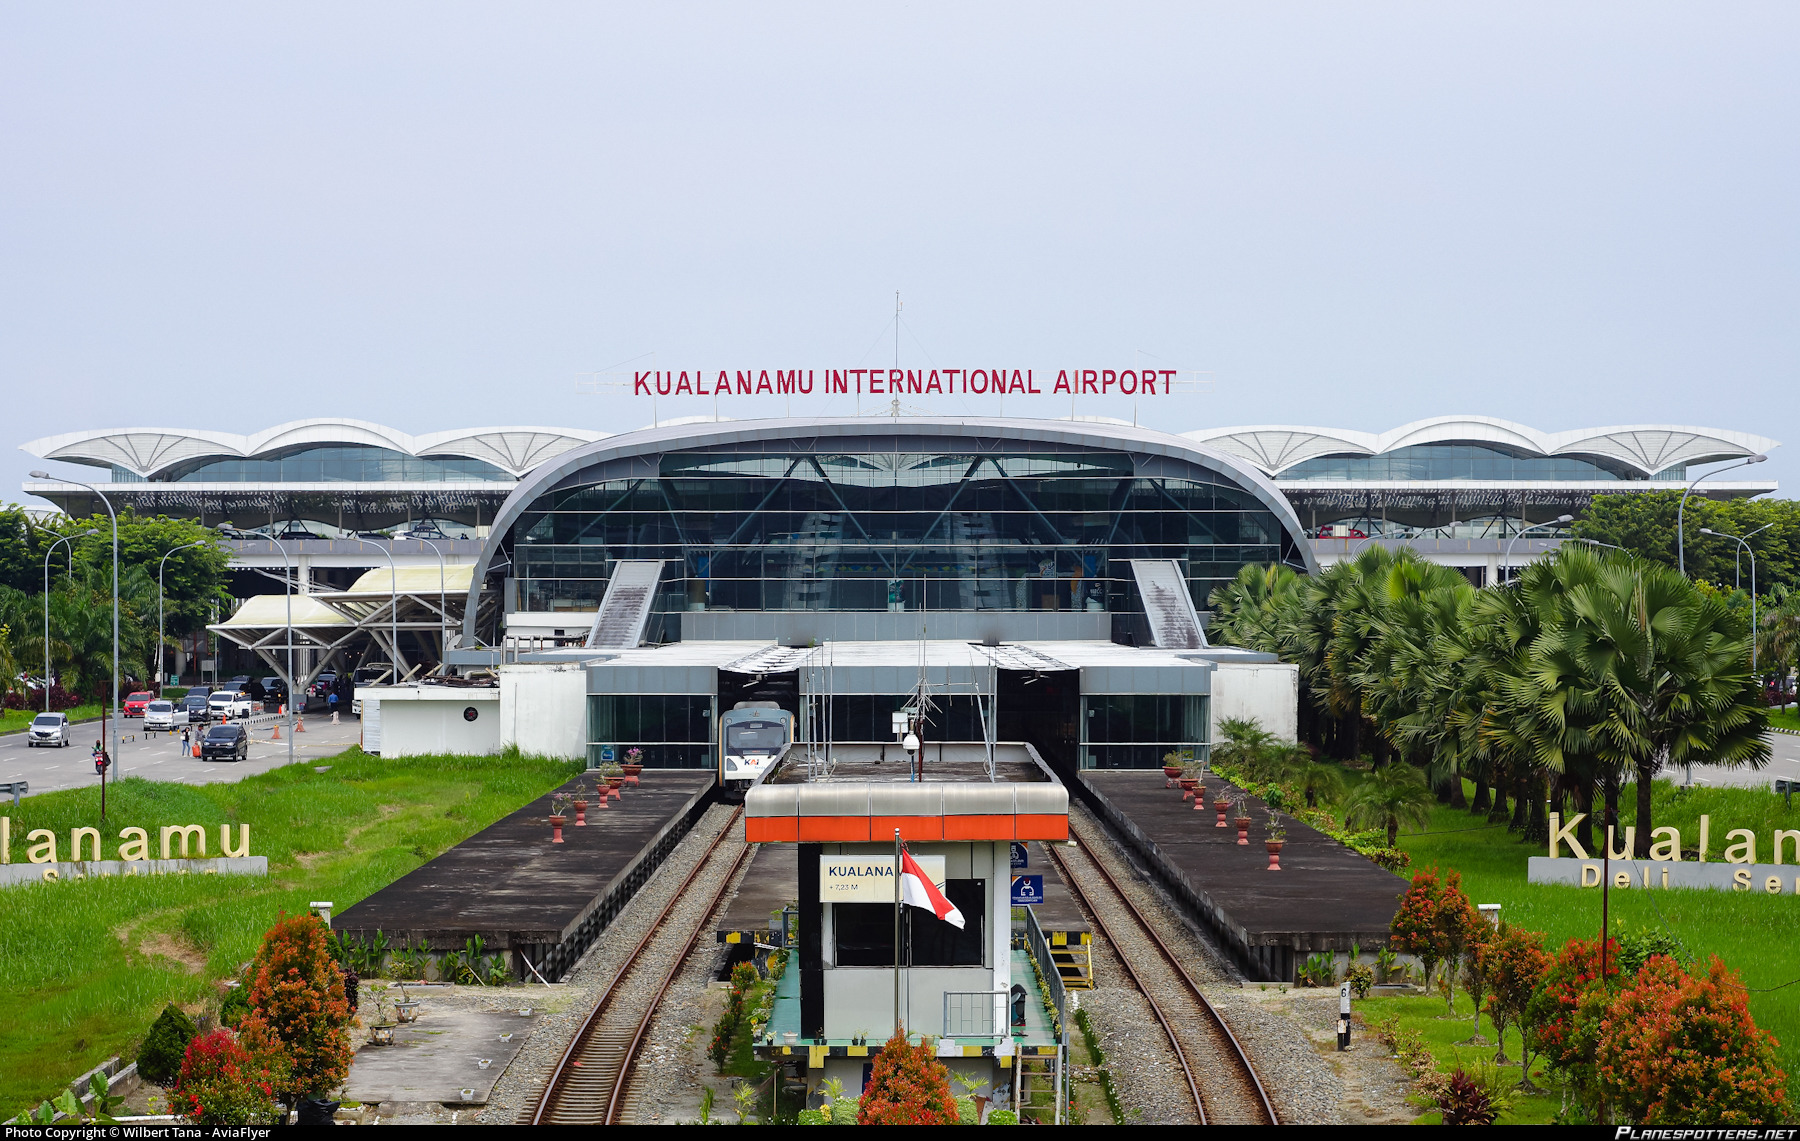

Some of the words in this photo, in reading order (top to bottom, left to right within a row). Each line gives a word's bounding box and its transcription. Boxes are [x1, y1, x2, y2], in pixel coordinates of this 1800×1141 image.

[634, 369, 813, 395] KUALANAMU
[825, 369, 1041, 394] INTERNATIONAL
[1053, 369, 1177, 395] AIRPORT
[0, 816, 250, 864] lanamu
[1549, 811, 1800, 865] Kualan
[829, 866, 902, 876] KUALANA
[1581, 864, 1669, 890] Deli
[1341, 987, 1347, 998] 6
